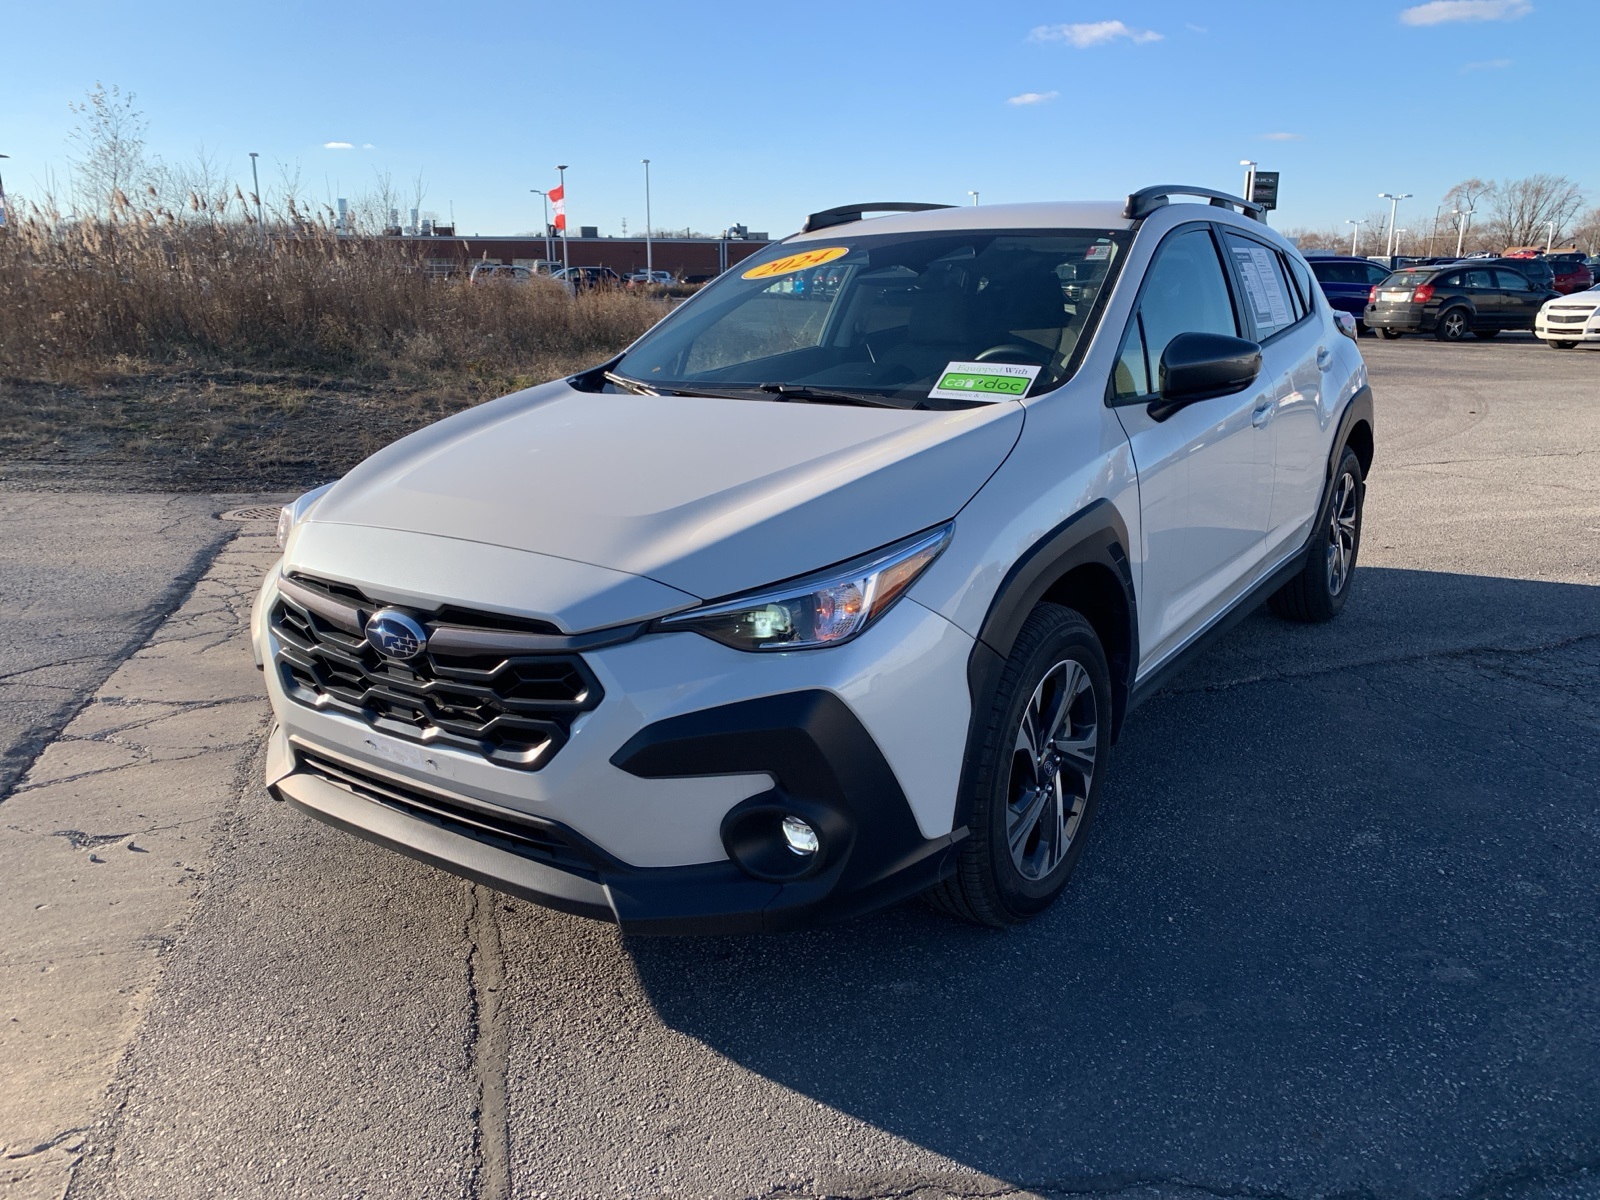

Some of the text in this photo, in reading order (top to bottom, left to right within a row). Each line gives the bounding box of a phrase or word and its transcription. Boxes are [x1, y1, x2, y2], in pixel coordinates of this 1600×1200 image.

[754, 249, 834, 277] 2024
[956, 364, 1028, 375] Equipped With
